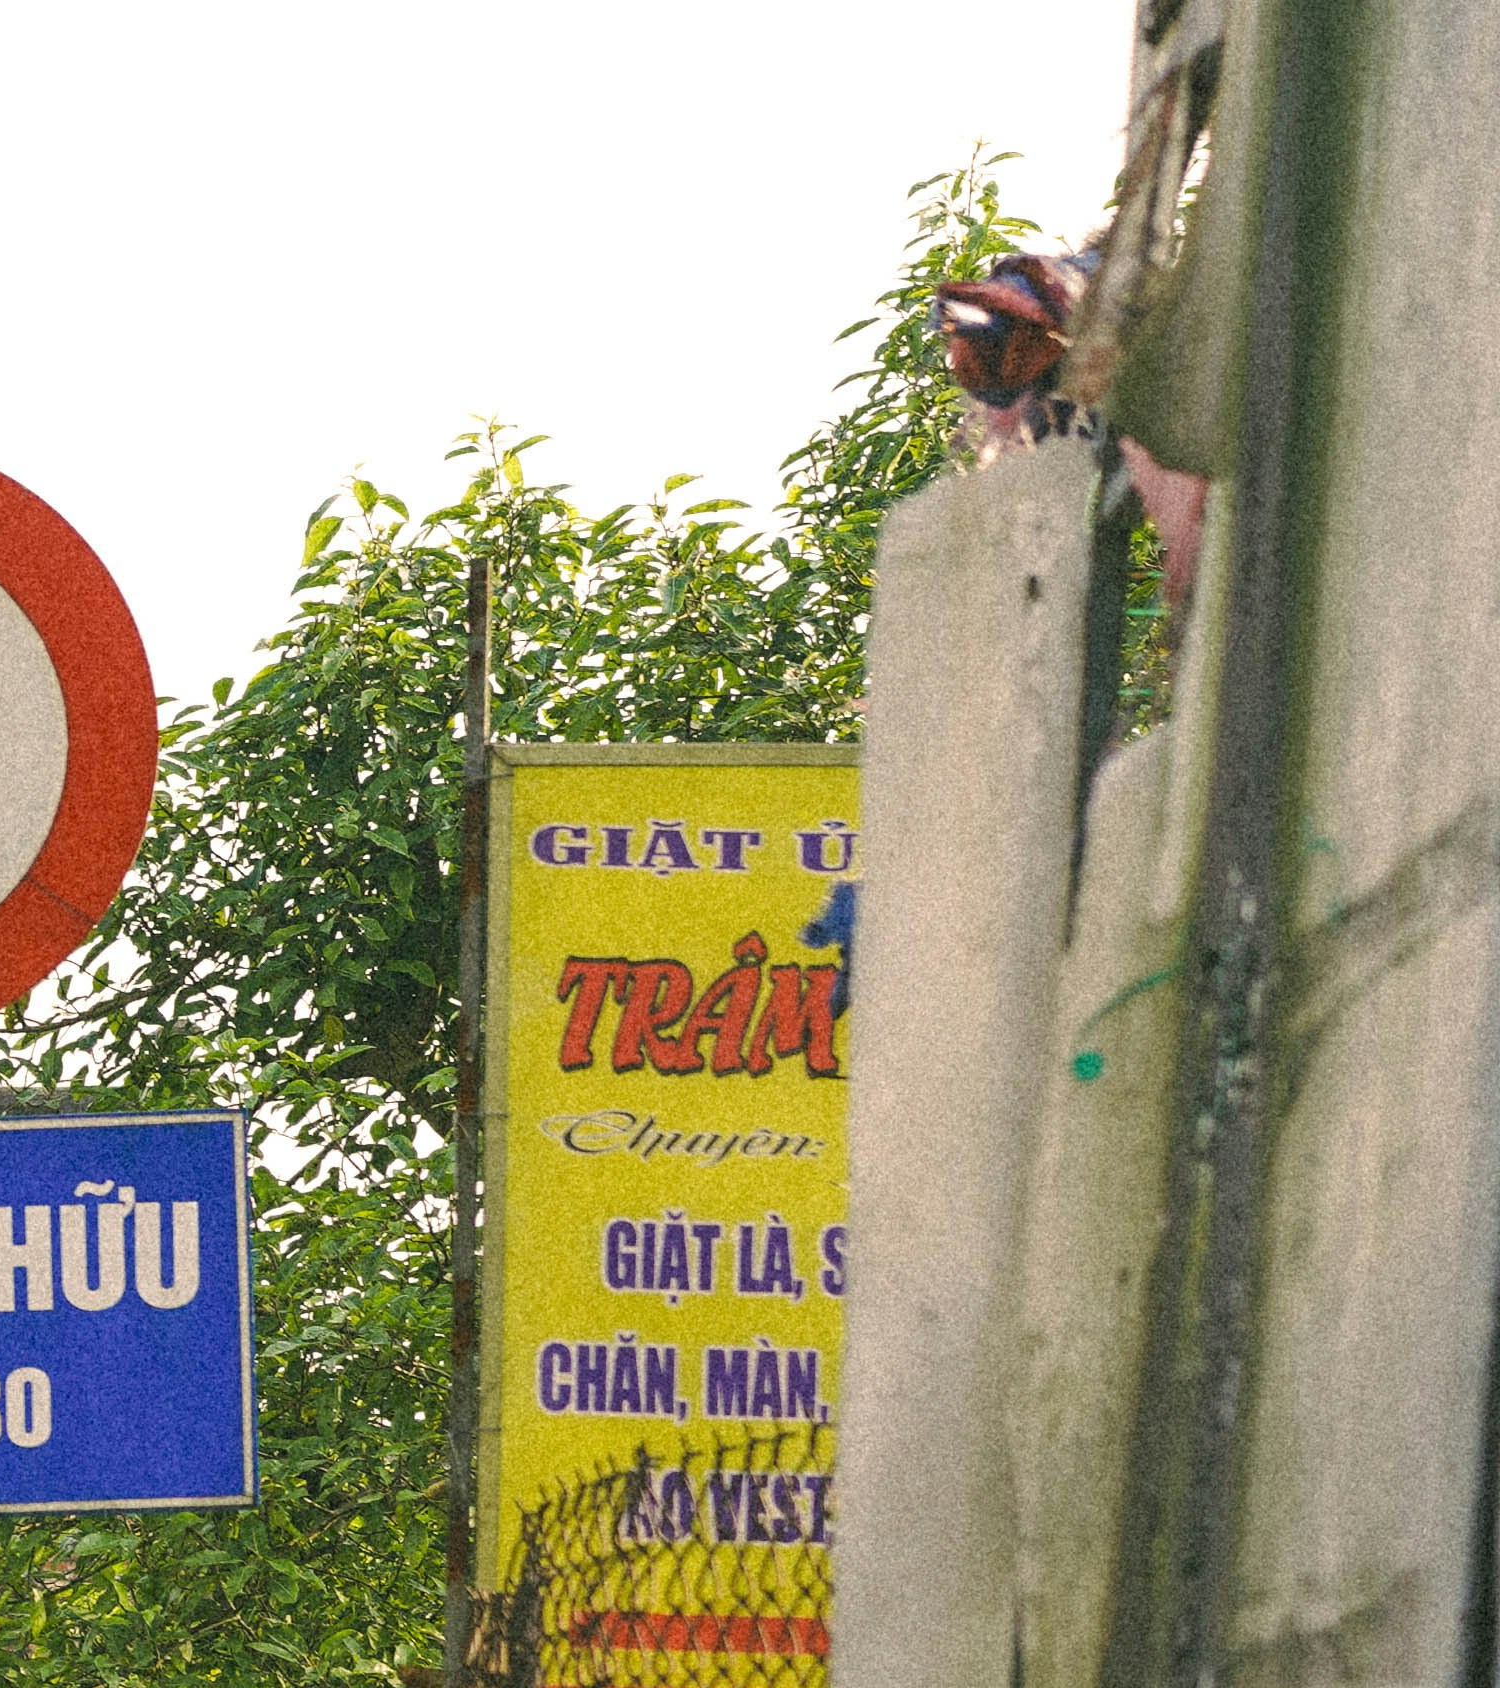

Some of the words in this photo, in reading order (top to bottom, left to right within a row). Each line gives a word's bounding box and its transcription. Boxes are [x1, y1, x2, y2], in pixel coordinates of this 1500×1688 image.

[534, 822, 760, 874] GIẶT
[556, 931, 839, 1077] TRÂM
[540, 1110, 825, 1165] Chuyên:
[605, 1211, 722, 1304] GIẶT
[737, 1214, 802, 1300] LÀ,
[538, 1335, 688, 1420] CHĂN,
[708, 1339, 828, 1423] MÀN,
